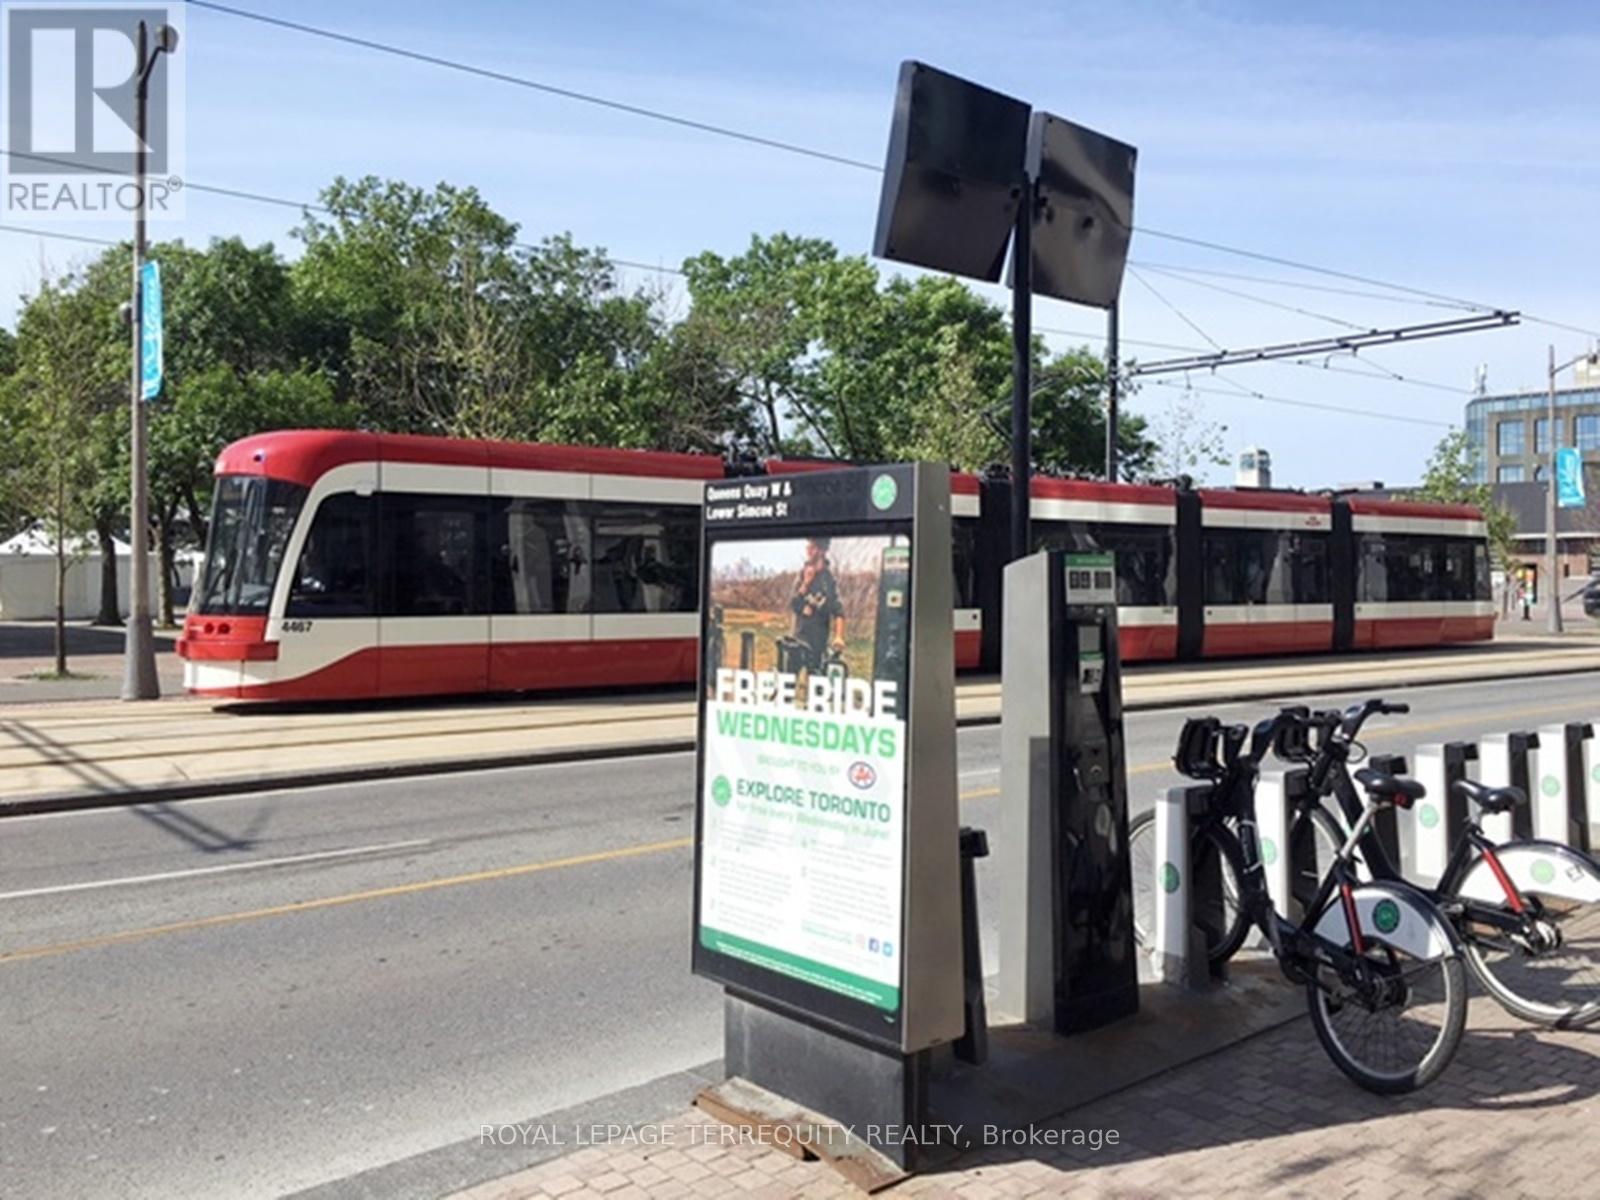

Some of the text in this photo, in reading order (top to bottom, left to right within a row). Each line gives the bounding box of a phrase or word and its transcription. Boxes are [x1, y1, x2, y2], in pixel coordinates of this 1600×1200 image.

[706, 502, 788, 520] Lower Simcoe St
[744, 483, 768, 500] Quay
[771, 482, 781, 497] W
[716, 667, 898, 719] FREE RIDE
[716, 709, 898, 759] WEDNESDAYS
[736, 778, 891, 823] EXPLORE TORONTO
